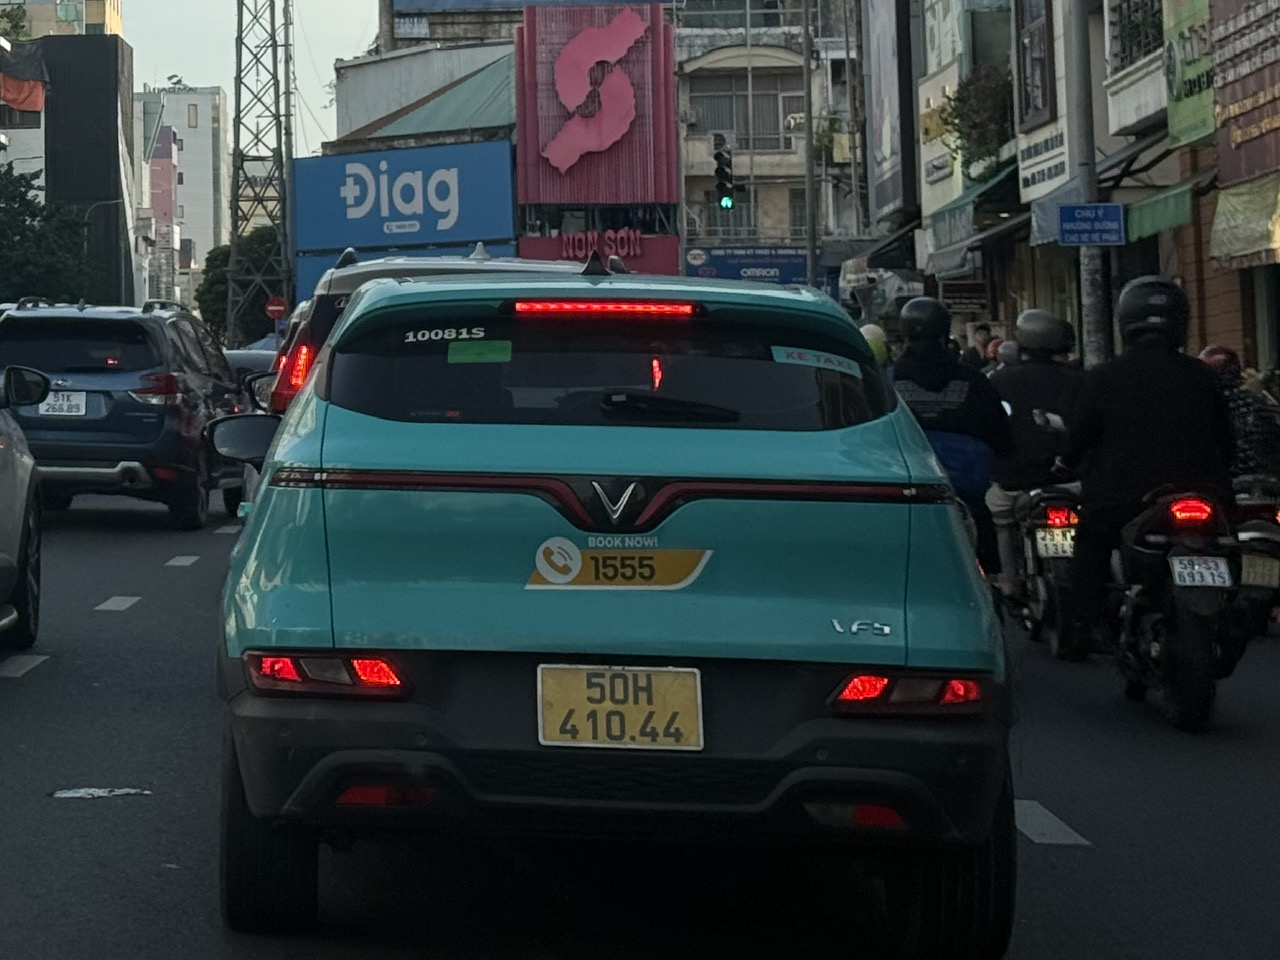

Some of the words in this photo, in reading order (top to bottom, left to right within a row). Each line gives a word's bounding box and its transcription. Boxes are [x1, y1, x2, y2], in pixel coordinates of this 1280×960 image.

[404, 327, 485, 342] 10081S
[588, 537, 622, 548] BOOK
[624, 537, 658, 548] NOW!
[589, 555, 656, 582] 1555
[585, 672, 654, 705] 50H
[558, 708, 684, 742] 410.44
